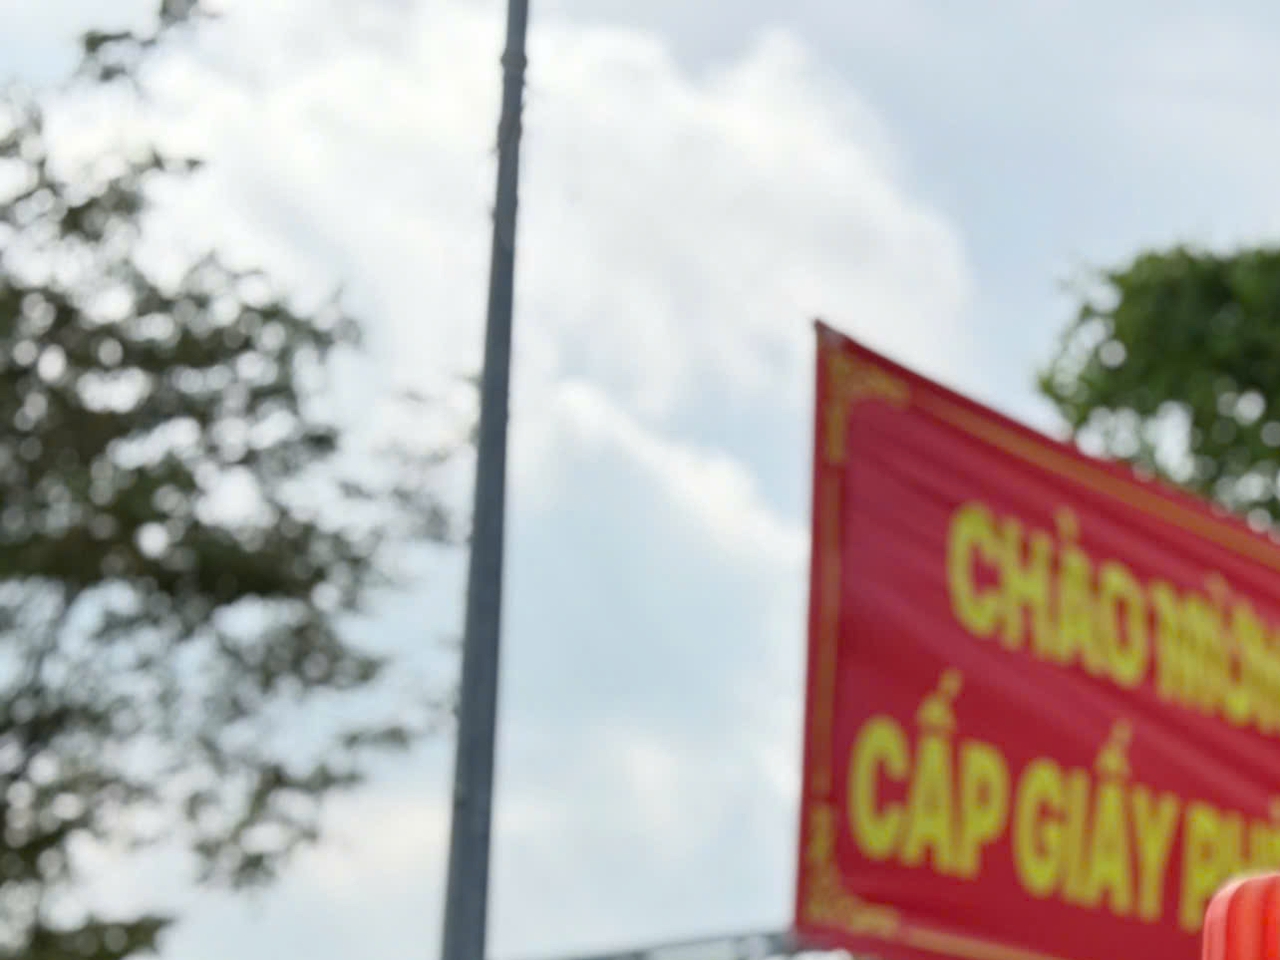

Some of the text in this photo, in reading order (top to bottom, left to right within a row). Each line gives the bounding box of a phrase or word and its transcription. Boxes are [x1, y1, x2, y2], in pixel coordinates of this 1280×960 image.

[947, 500, 1146, 690] CHÀO
[848, 669, 1009, 880] CẤP
[1012, 717, 1181, 921] GIẤY
